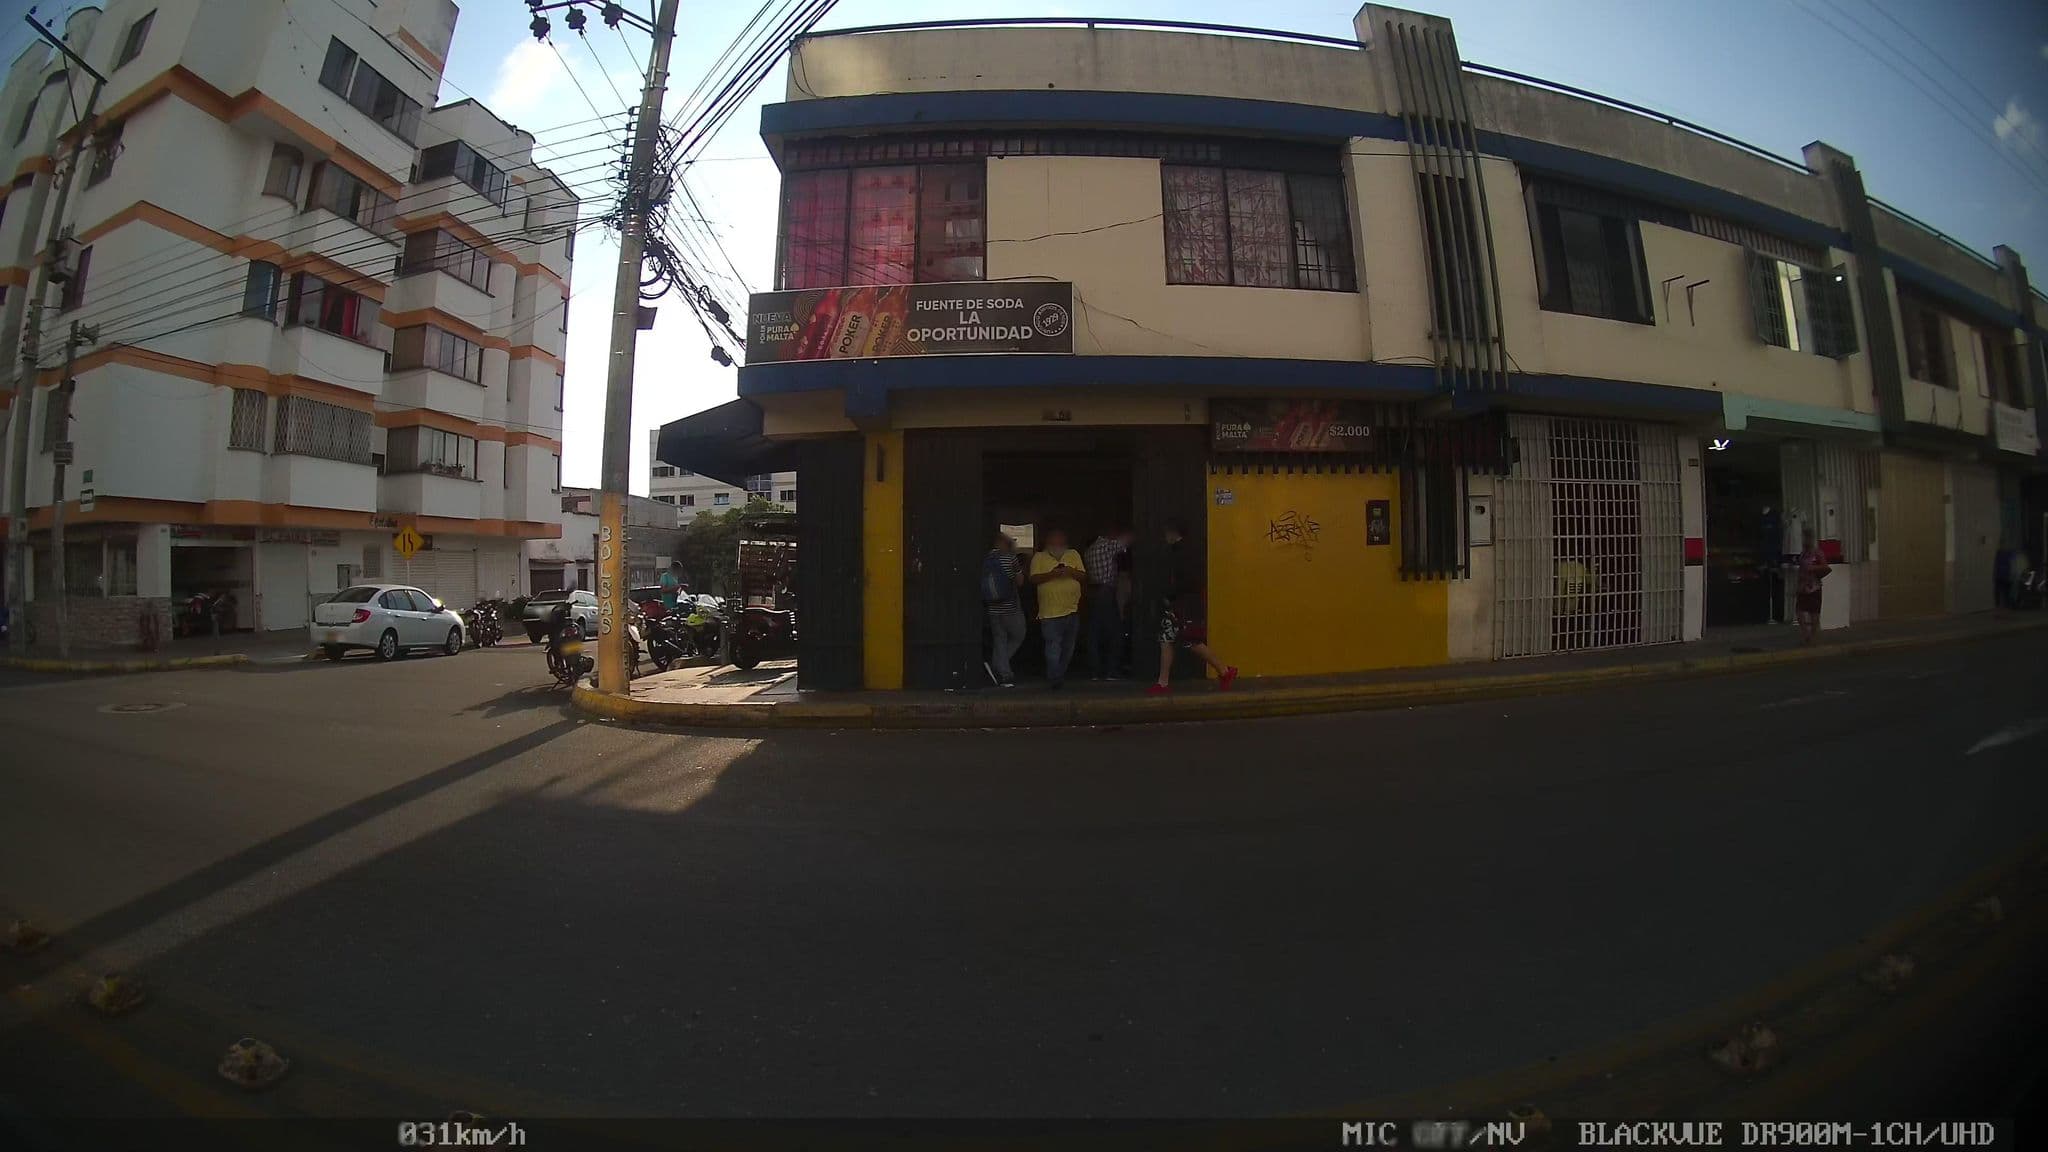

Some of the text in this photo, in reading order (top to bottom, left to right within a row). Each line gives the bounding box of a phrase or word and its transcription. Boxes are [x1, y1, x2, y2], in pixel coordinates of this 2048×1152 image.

[916, 298, 1024, 311] FUENTE DE SODA
[752, 312, 793, 325] NUEVA
[959, 311, 981, 325] LA
[1042, 313, 1059, 327] 1929
[766, 326, 791, 334] PURA
[838, 314, 863, 354] POKER
[906, 325, 1033, 342] OPORTUNIDAD
[766, 333, 794, 342] MALTA
[1329, 425, 1370, 437] $2.000
